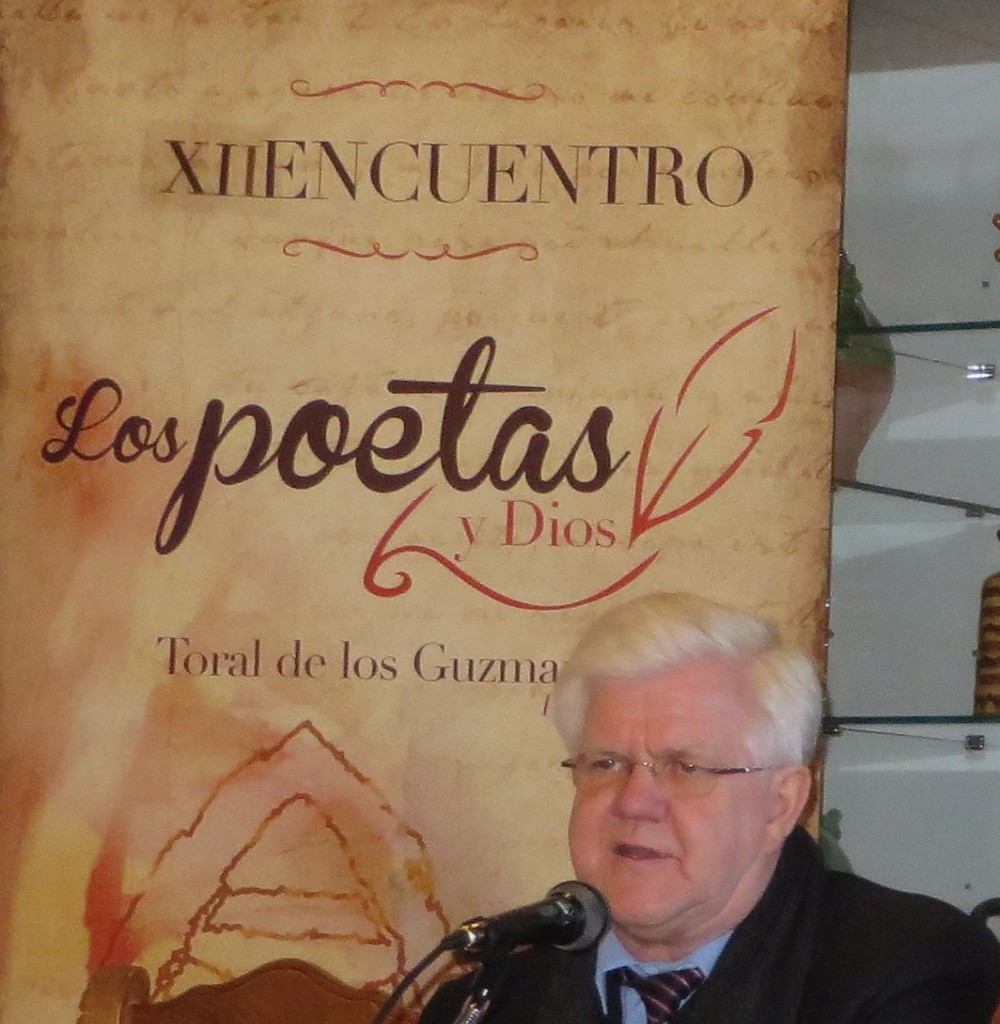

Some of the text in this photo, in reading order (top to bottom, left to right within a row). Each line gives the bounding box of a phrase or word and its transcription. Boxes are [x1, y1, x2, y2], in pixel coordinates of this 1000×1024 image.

[262, 138, 755, 208] ENCUENTRO
[40, 335, 631, 556] Los poetas
[454, 499, 617, 562] y Dios
[156, 636, 567, 685] Toral de los Guzma
